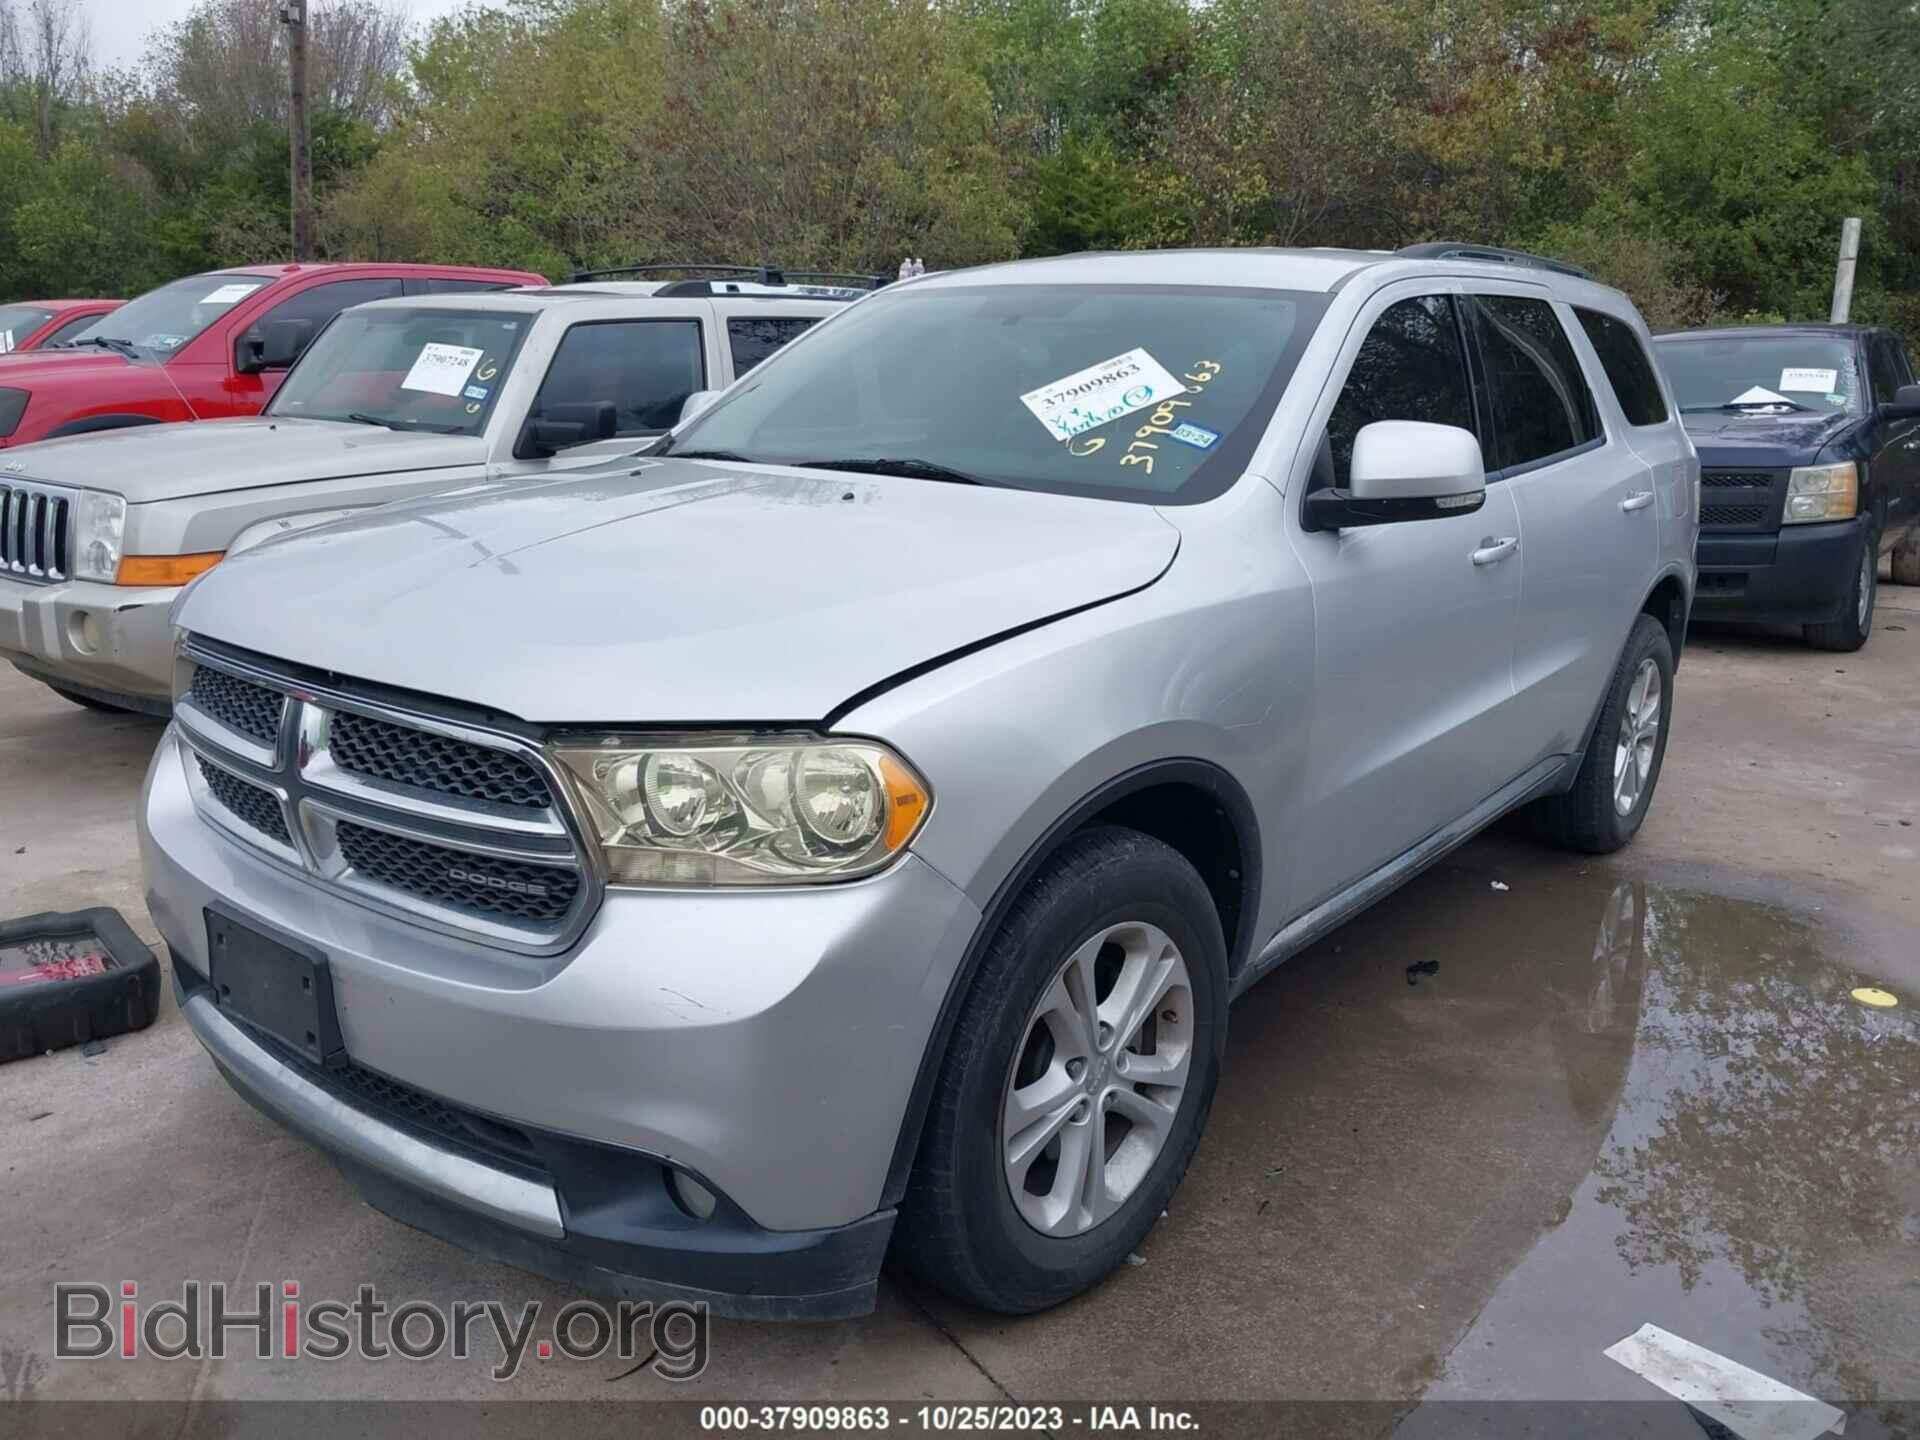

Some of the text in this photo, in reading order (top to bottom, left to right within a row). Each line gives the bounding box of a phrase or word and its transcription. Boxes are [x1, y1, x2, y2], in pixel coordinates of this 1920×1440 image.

[1041, 363, 1141, 410] 37909863
[1175, 426, 1212, 444] 03-24
[448, 868, 548, 897] DODGE
